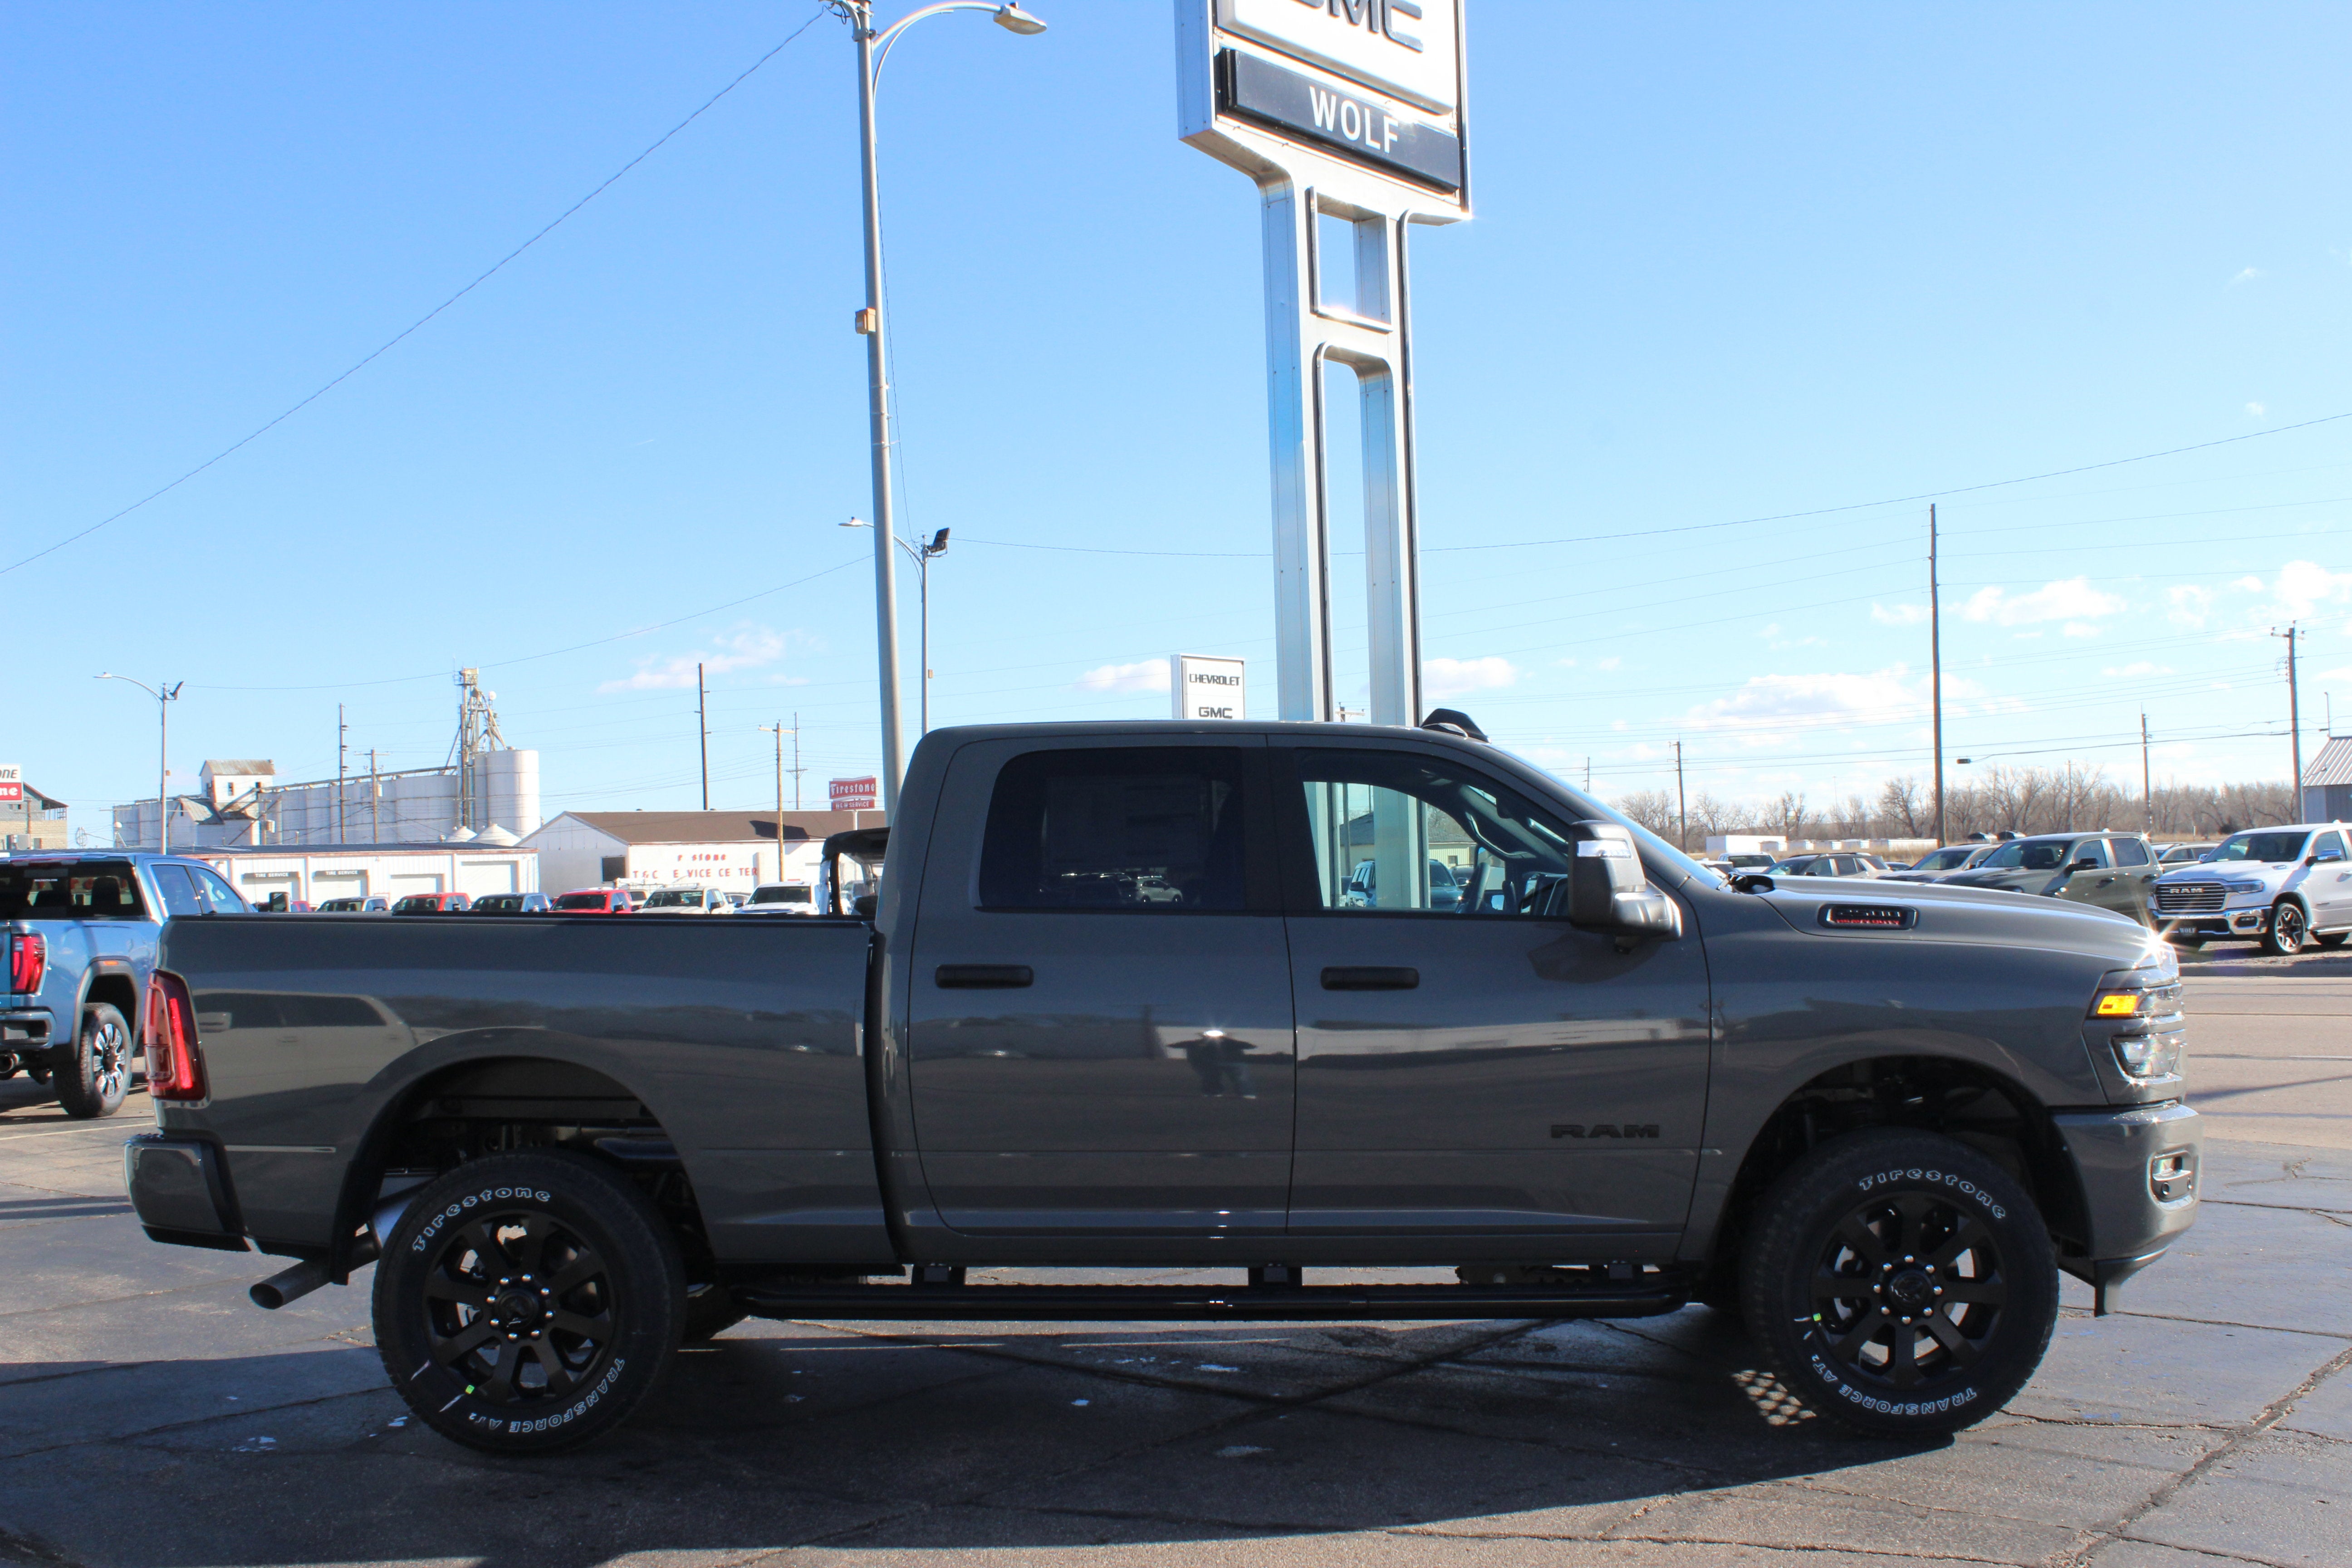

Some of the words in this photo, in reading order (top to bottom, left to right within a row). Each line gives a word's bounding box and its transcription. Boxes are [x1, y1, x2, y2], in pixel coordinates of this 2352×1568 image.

[1291, 0, 1424, 53] MC
[1309, 86, 1399, 153] WOLF
[1189, 673, 1240, 686] CHEVROLET
[1198, 706, 1233, 719] GMC
[830, 783, 875, 796] Firestone
[1551, 1124, 1660, 1138] RAM
[509, 1357, 625, 1433] TRANSFORCE
[1839, 1383, 1977, 1415] TRANSFORCE
